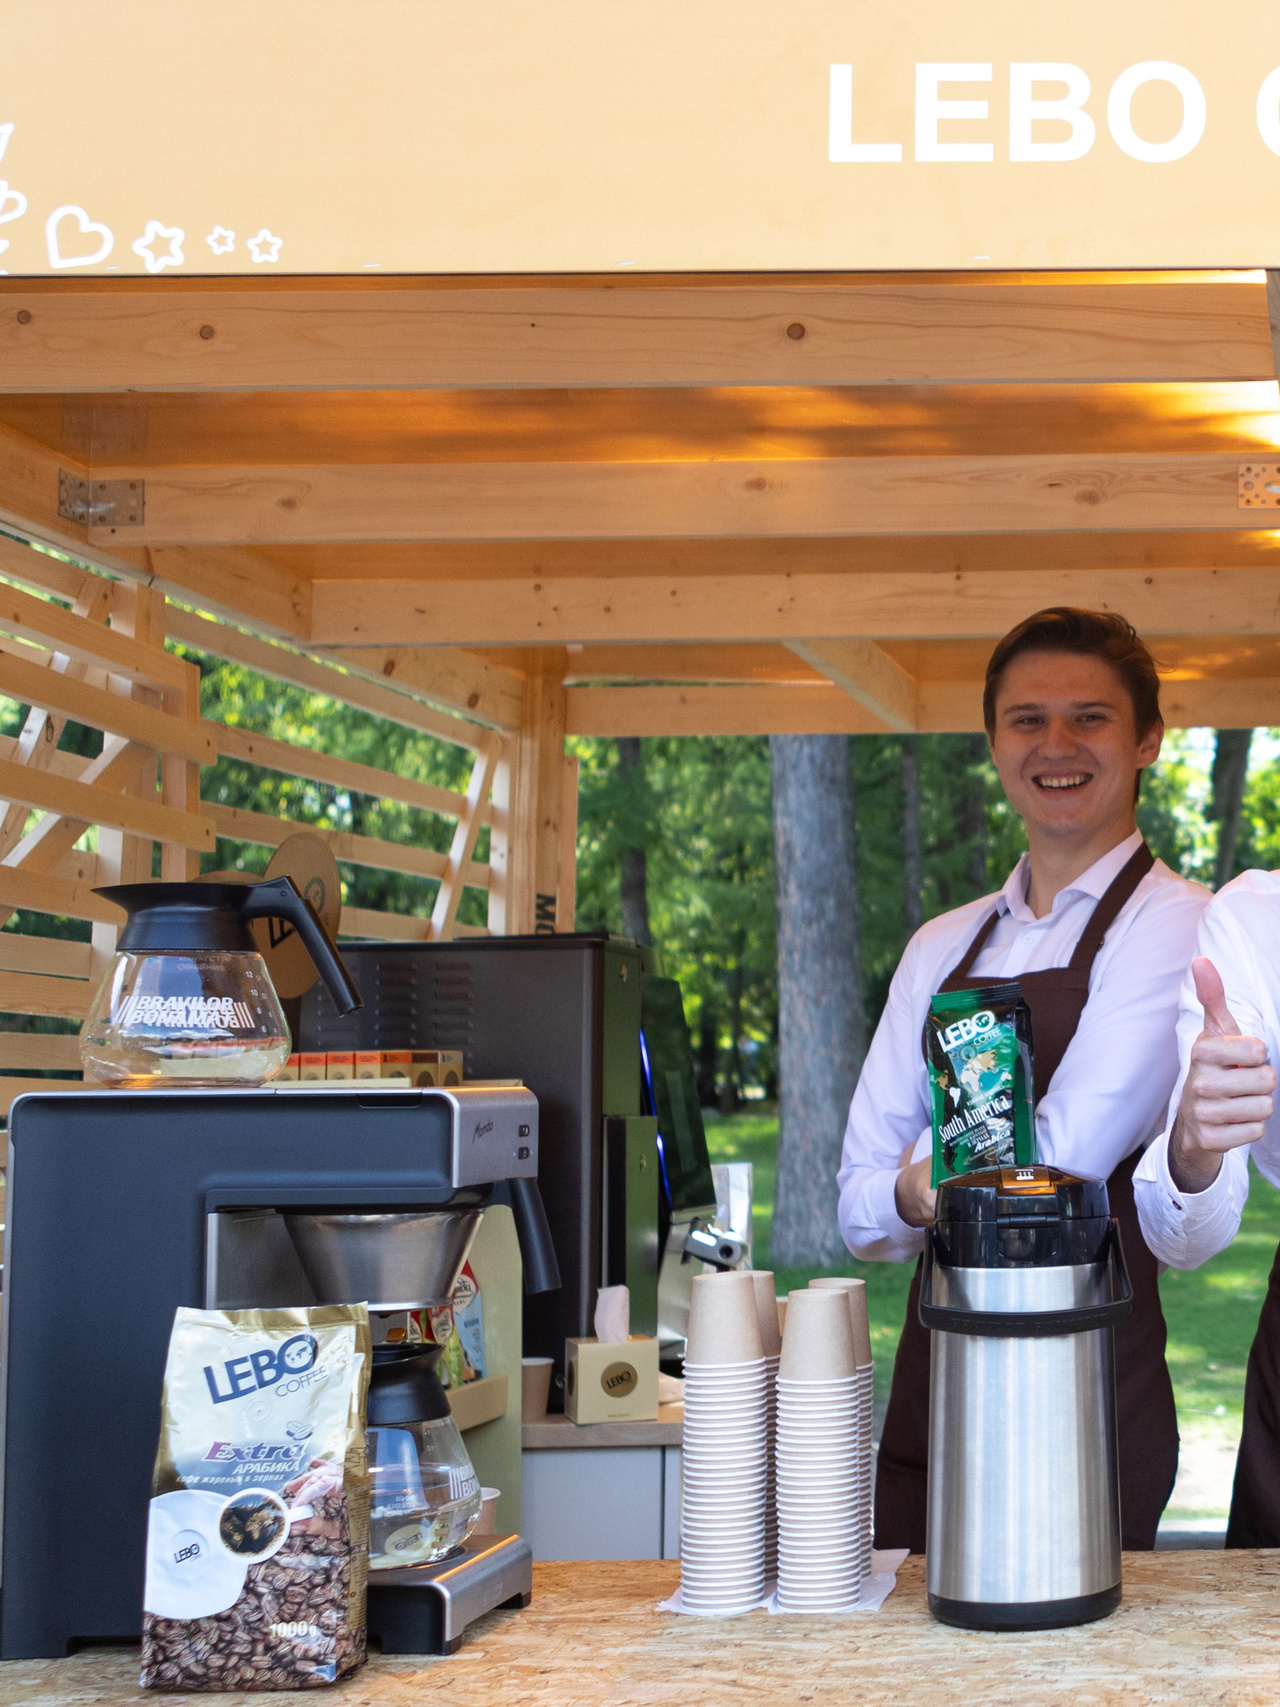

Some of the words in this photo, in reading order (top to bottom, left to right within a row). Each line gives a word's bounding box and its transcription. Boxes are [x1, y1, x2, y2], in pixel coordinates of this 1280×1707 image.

[829, 60, 1207, 163] LEBO
[135, 995, 235, 1011] BRAVILOR
[937, 1011, 996, 1053] LEBO
[972, 1026, 1002, 1046] COFFEE
[938, 1114, 966, 1144] South
[963, 1095, 1013, 1129] America
[974, 1129, 1011, 1153] Arabica
[203, 1333, 319, 1405] LEBO
[605, 1371, 632, 1389] LEBO
[275, 1365, 329, 1397] COFFEE
[202, 1441, 309, 1463] Extra
[232, 1461, 300, 1475] АРАБИКА
[173, 1543, 201, 1563] LEBO
[269, 1620, 308, 1639] 1000
